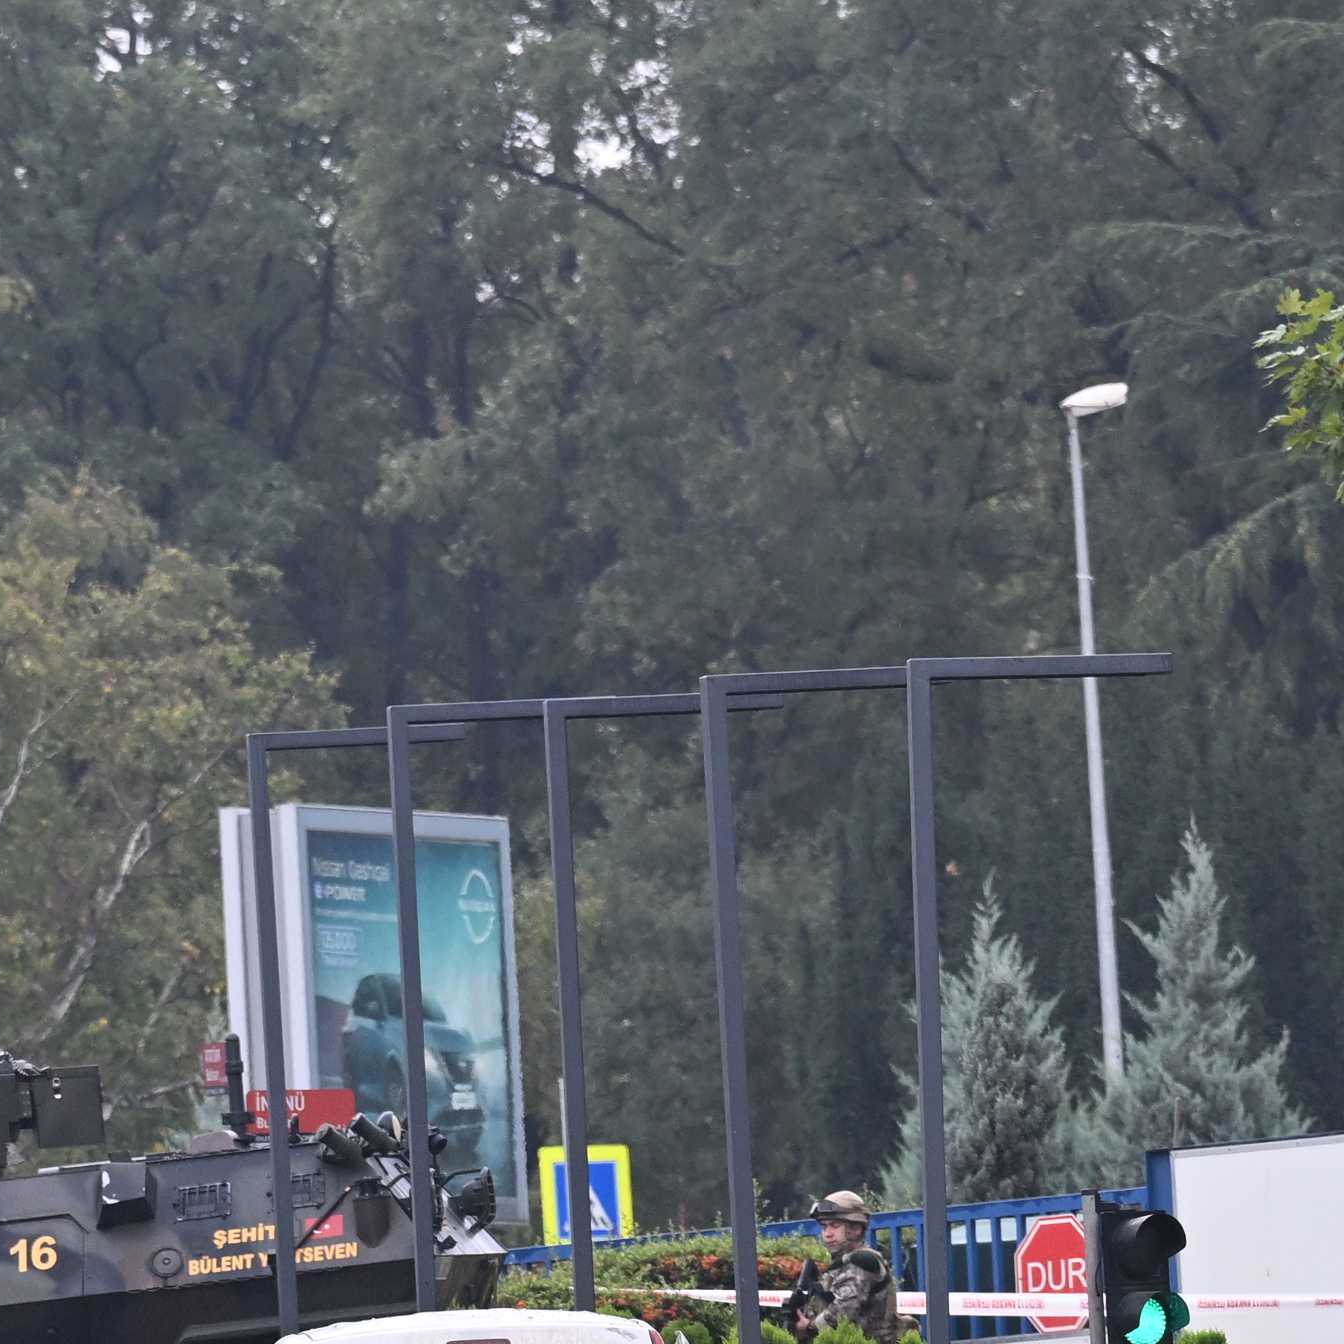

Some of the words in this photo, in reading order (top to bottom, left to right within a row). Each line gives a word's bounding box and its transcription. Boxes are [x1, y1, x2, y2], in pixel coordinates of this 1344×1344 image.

[256, 1091, 305, 1111] İNNÜ
[213, 1223, 276, 1249] ŞEHİT
[9, 1236, 57, 1273] 16
[188, 1253, 255, 1276] BÜLENT
[258, 1242, 358, 1267] YTSEVEN
[1027, 1258, 1088, 1292] DUR
